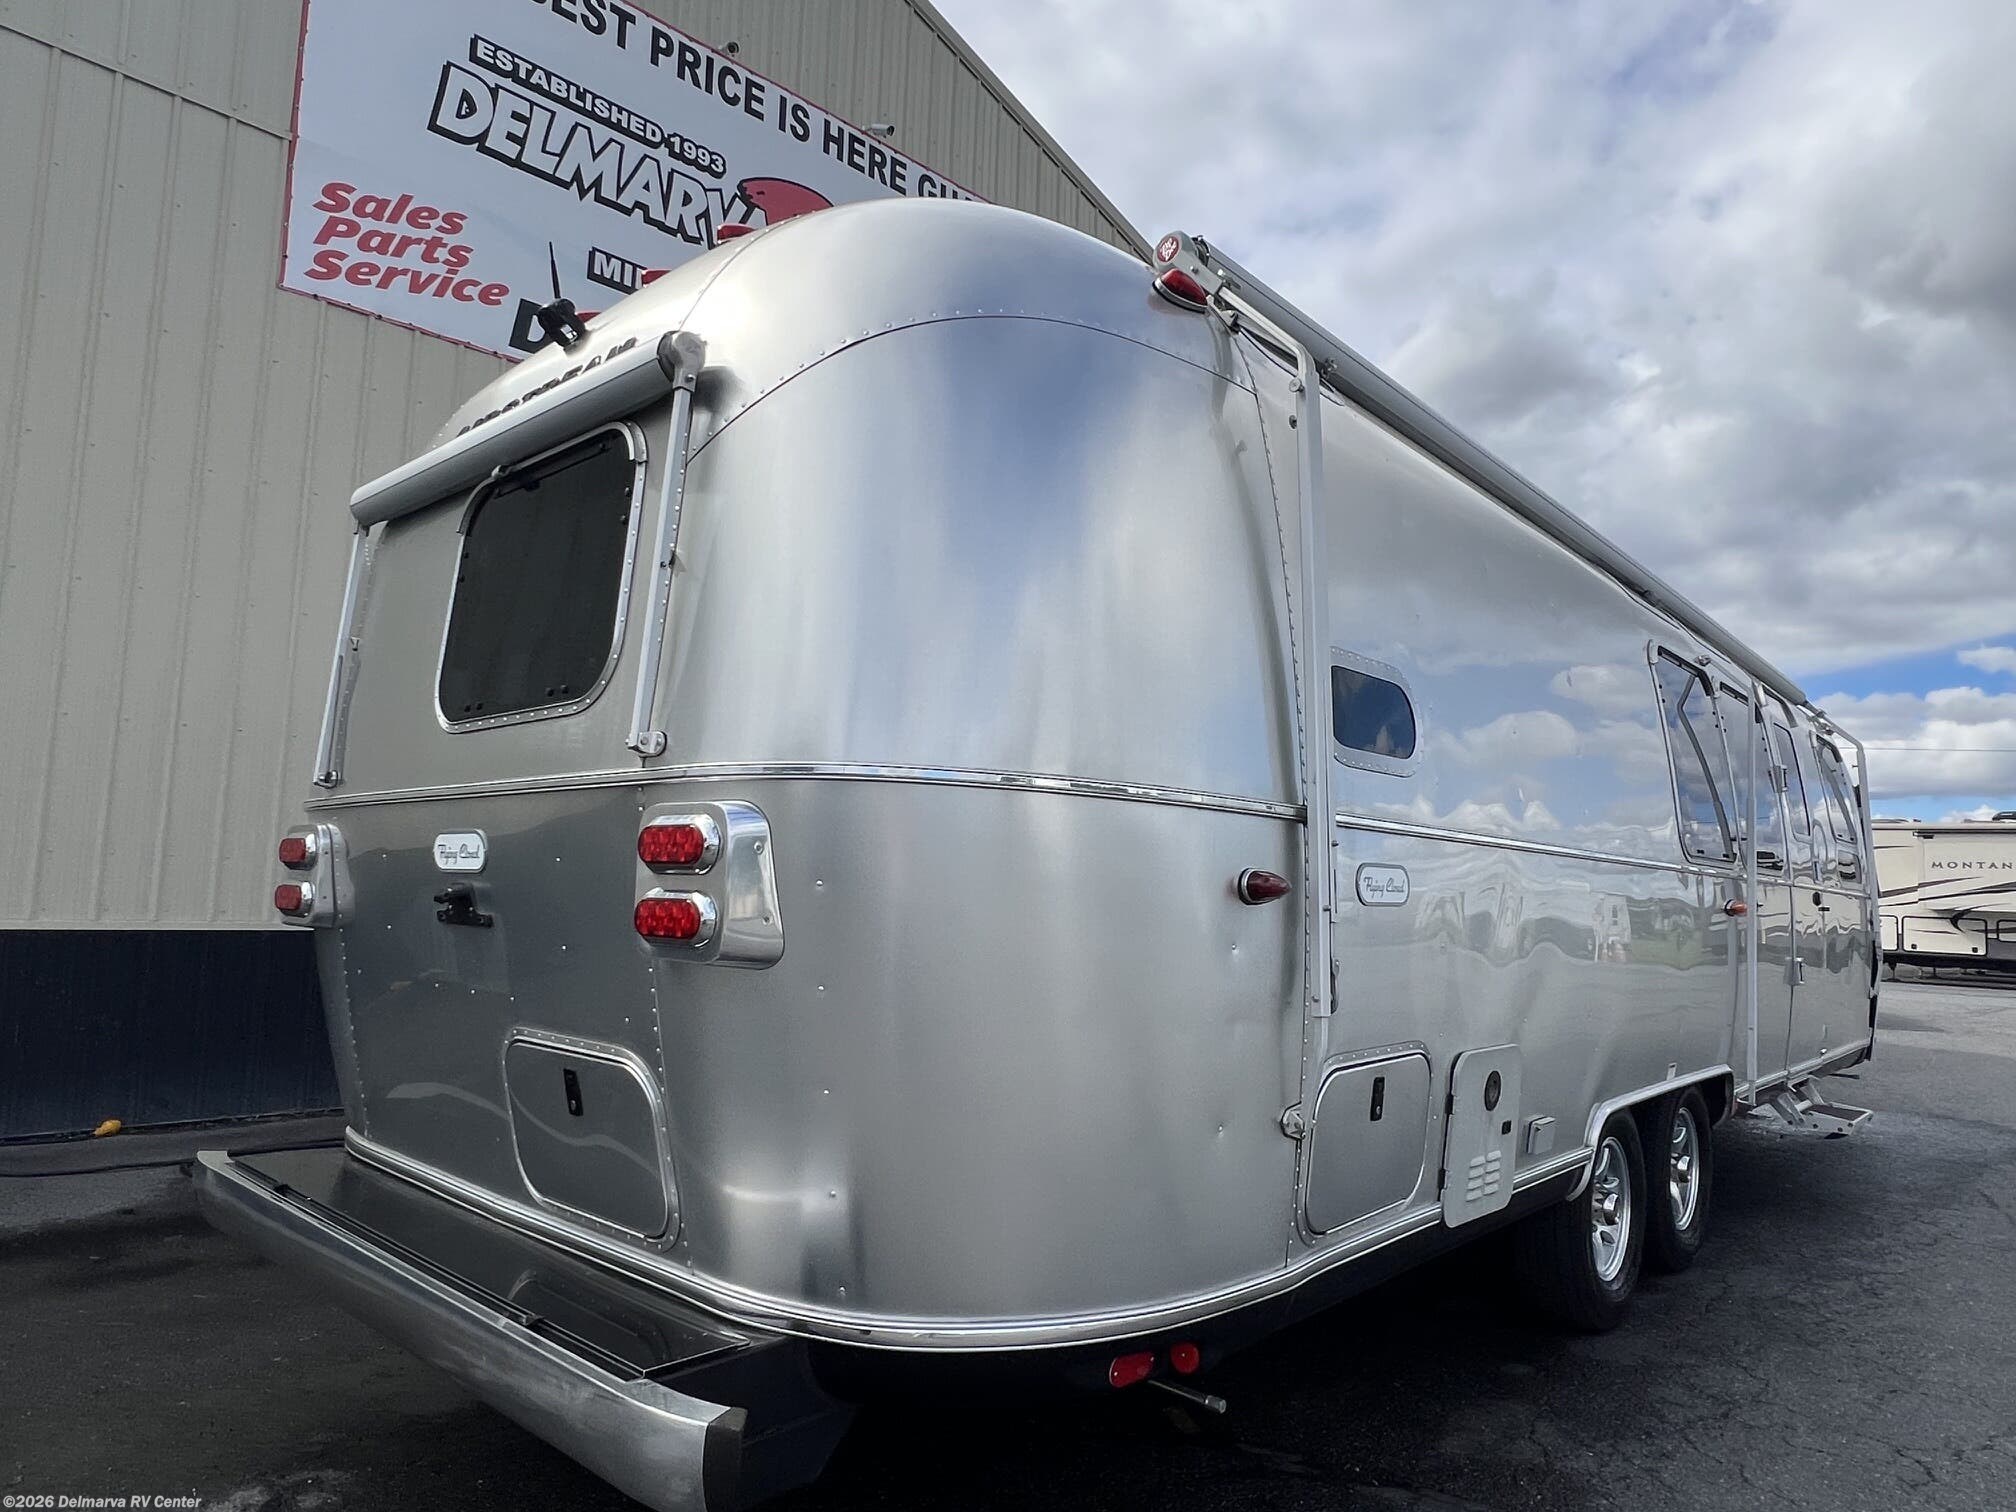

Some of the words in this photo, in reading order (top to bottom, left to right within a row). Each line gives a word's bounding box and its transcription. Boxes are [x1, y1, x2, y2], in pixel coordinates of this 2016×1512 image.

[427, 60, 768, 249] DELMARV
[474, 40, 663, 144] ESTABLISHED
[669, 134, 727, 177] 1993
[650, 25, 765, 121] PRICE
[778, 95, 811, 143] IS
[823, 118, 907, 196] HERE
[312, 182, 469, 235] Sales
[313, 215, 474, 269] Parts
[304, 249, 510, 306] Service
